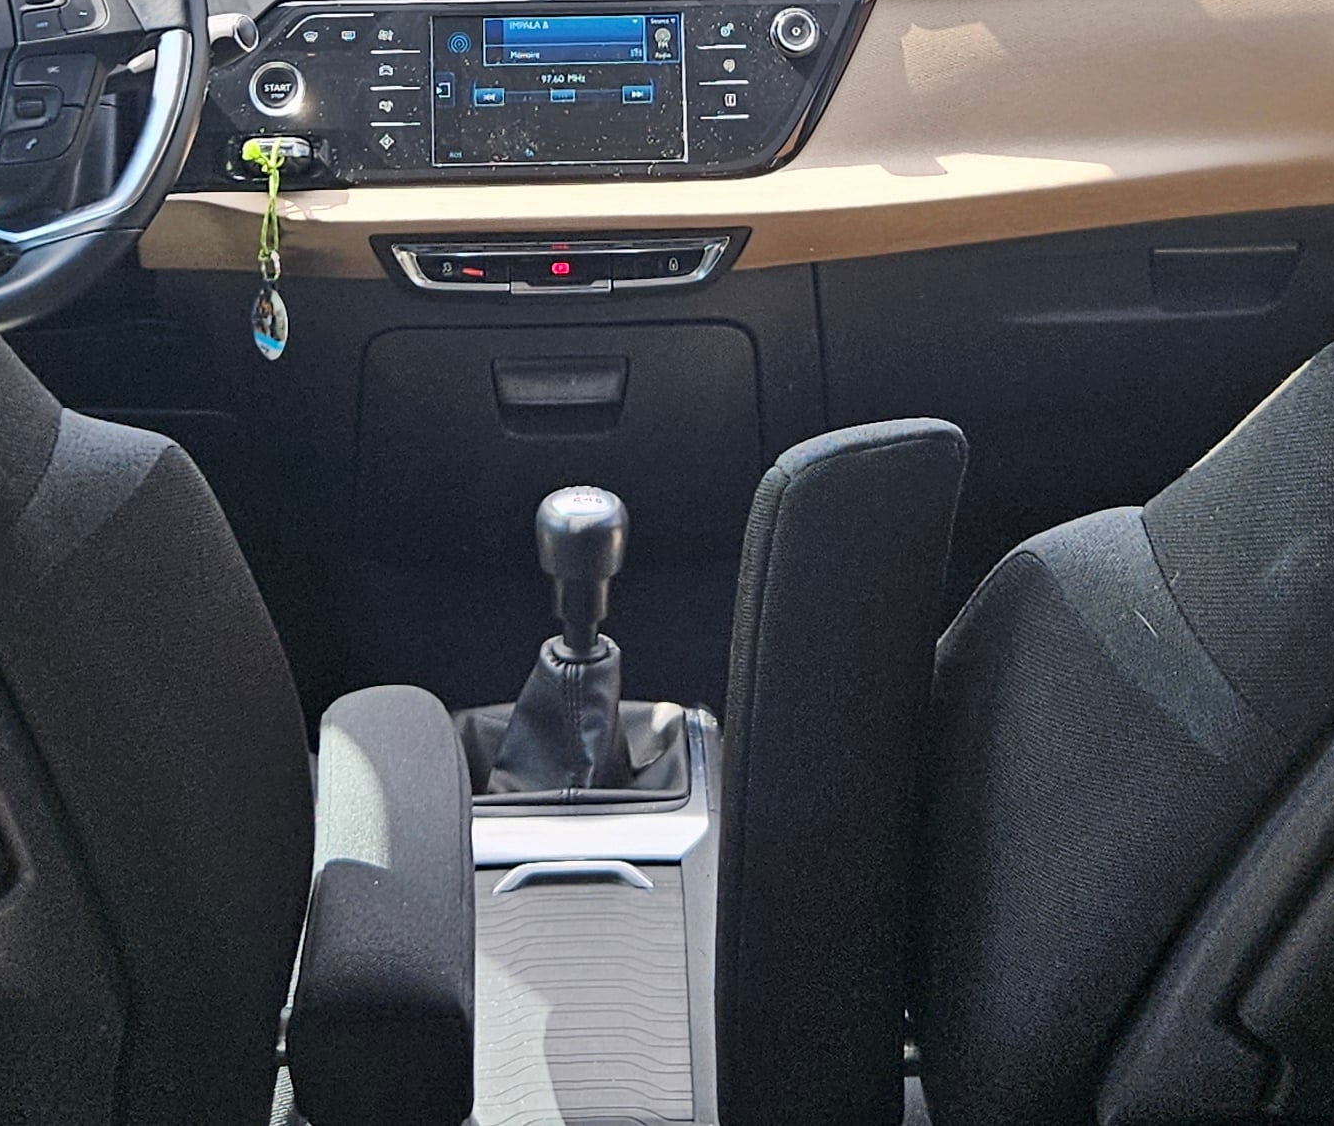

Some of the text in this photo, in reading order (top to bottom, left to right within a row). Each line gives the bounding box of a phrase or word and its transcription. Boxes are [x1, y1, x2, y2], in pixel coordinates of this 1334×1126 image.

[509, 20, 541, 30] IMPALA
[567, 74, 586, 83] MHz
[263, 82, 292, 93] START
